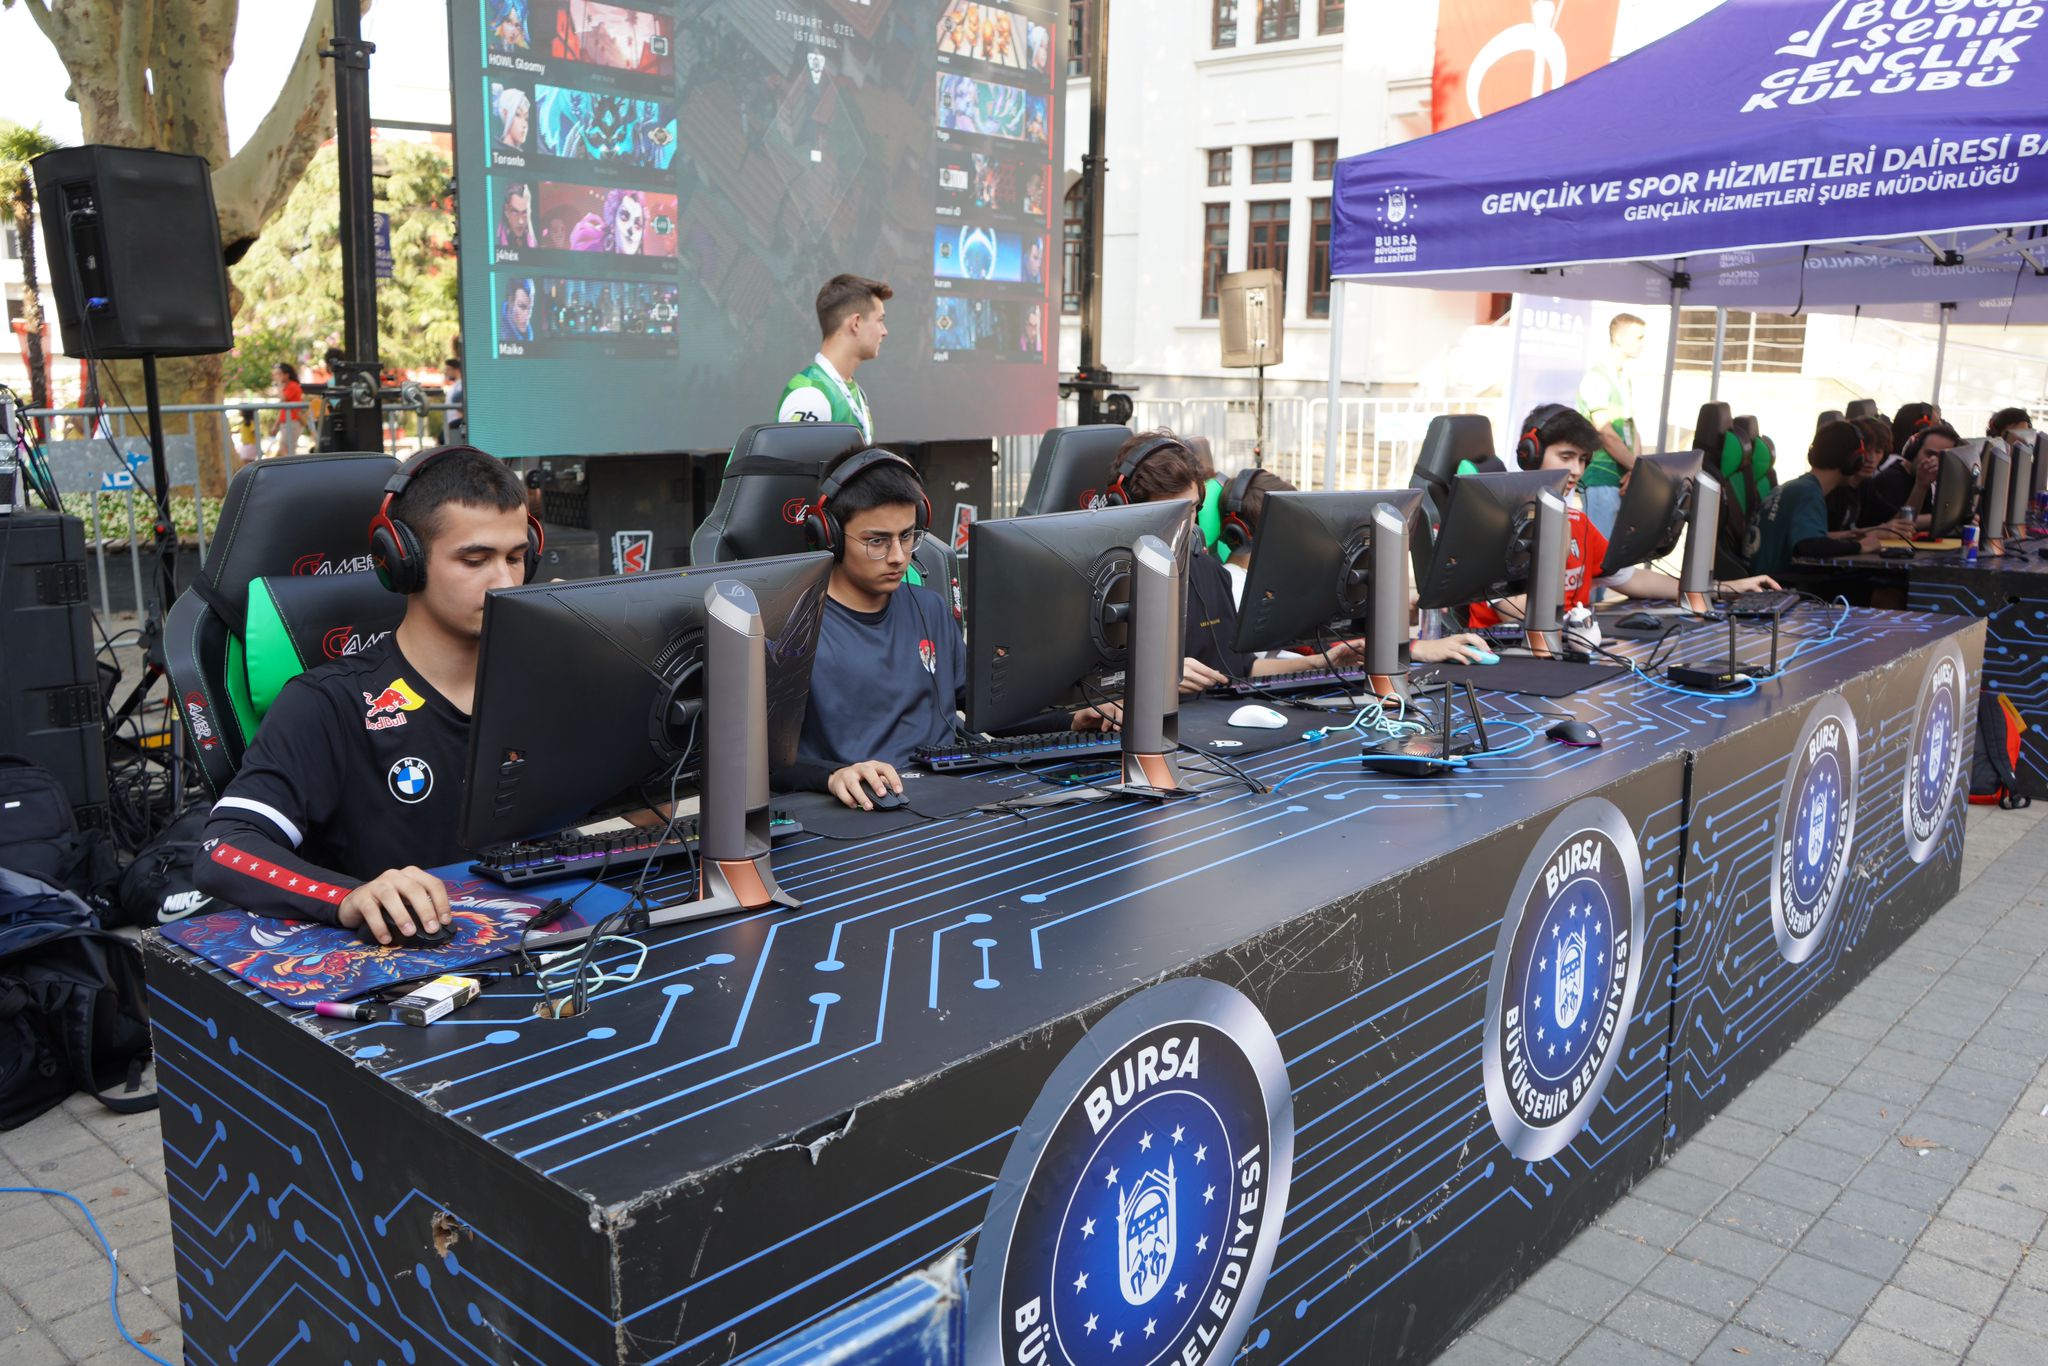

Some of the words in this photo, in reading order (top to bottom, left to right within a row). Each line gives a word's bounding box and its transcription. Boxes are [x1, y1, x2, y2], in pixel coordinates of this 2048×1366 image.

[1740, 65, 2014, 112] KULÜBÜ
[1760, 35, 2032, 89] GENÇLİK
[1481, 181, 1586, 216] GENÇLİK
[1590, 181, 1622, 204] VE
[1625, 171, 1699, 200] SPOR
[1704, 144, 1877, 191] HİZMETLERİ
[1882, 133, 2012, 172] DAİRESİ
[1624, 196, 1700, 221] GENÇLİK
[1703, 183, 1815, 213] HİZMETLERİ
[1819, 181, 1871, 206] ŞUBE
[1875, 162, 2019, 196] MÜDÜRLÜĞÜ
[1375, 234, 1417, 247] BURSA
[1932, 663, 1955, 695] BURSA
[384, 712, 407, 729] Bull
[1808, 724, 1840, 765] BURSA
[393, 760, 426, 775] BMW
[1545, 839, 1602, 899] BURSA
[163, 890, 203, 912] NIKE
[1571, 929, 1628, 1102] BELEDİYESİ
[1083, 1036, 1200, 1135] BURSA
[1505, 1005, 1569, 1120] BÜYÜKŞEHİR
[1172, 1144, 1260, 1366] ELEDİYESİ
